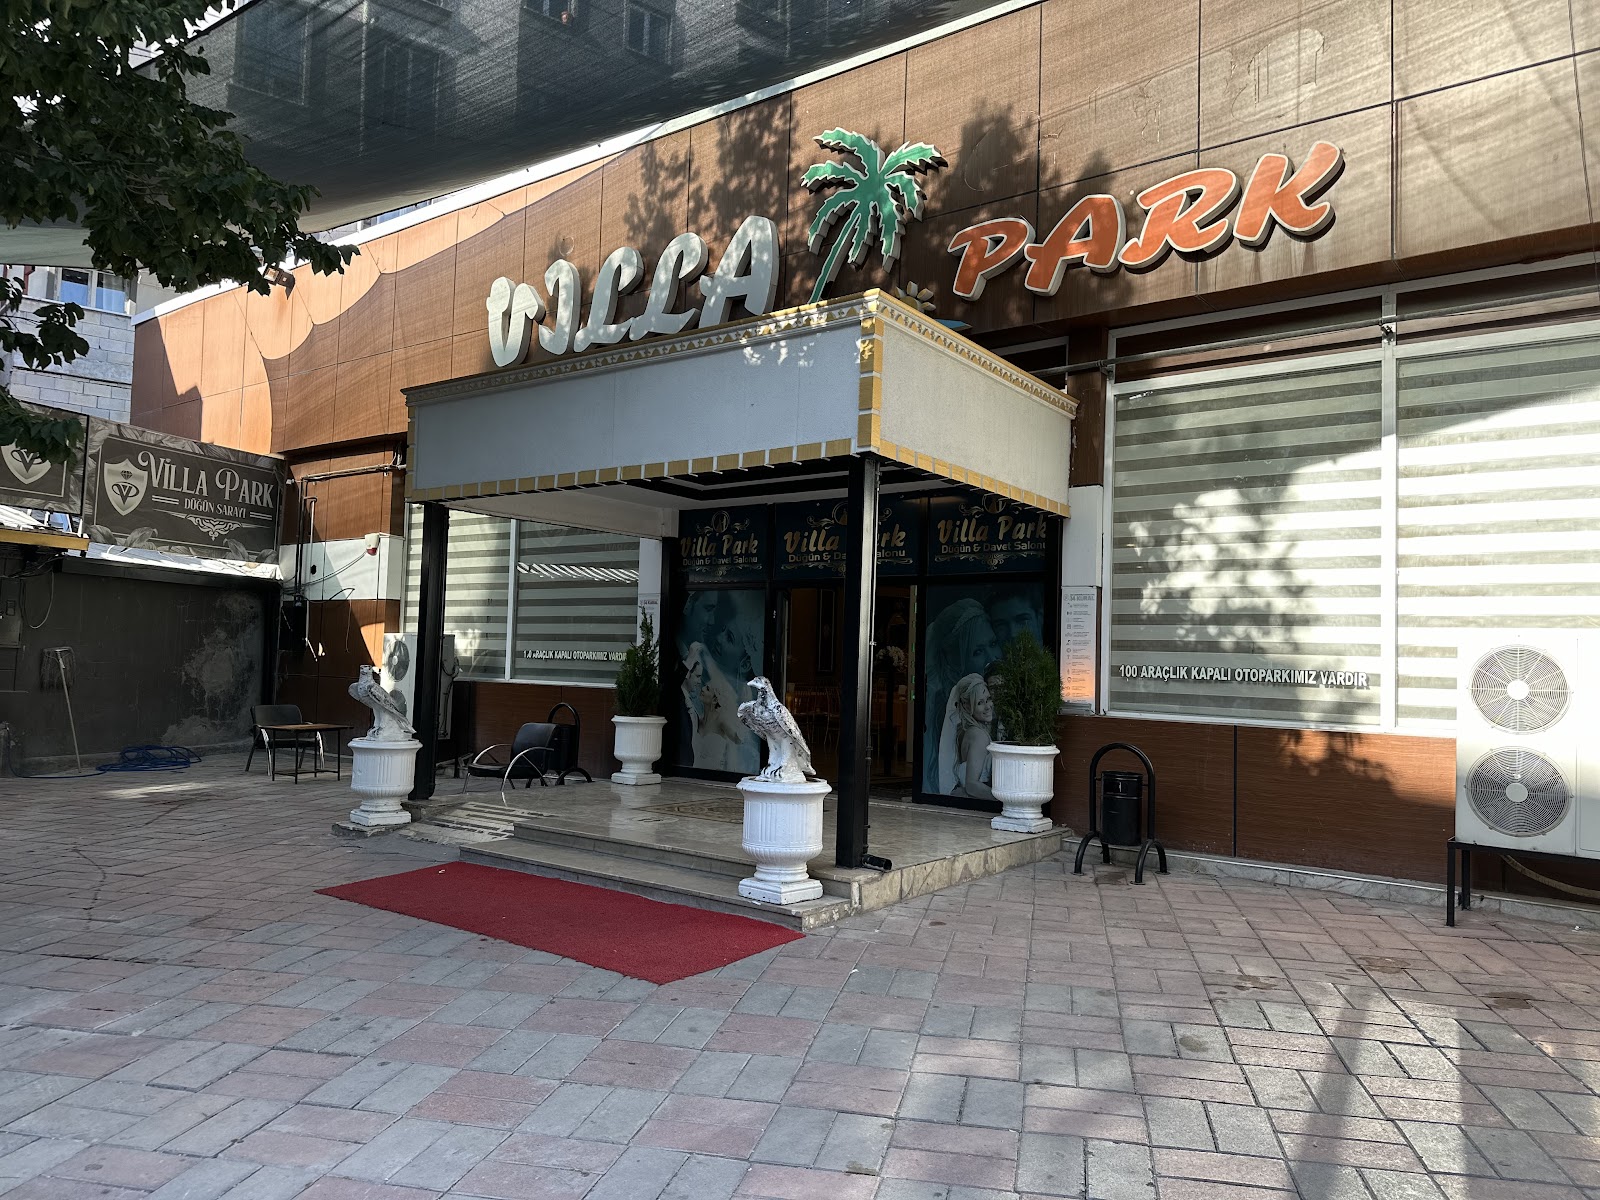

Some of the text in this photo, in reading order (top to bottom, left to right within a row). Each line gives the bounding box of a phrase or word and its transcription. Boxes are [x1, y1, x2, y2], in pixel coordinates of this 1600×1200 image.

[486, 140, 1344, 367] VILLA PARK
[215, 467, 274, 509] PARK
[184, 497, 246, 519] DÜĞÜN SARAYI
[783, 523, 907, 554] Villa rk
[937, 514, 1047, 545] Villa Park
[680, 532, 759, 558] Villa Park
[822, 552, 831, 562] &
[877, 548, 906, 559] alonu
[983, 542, 1012, 553] Davet
[733, 554, 758, 565] Salonu
[554, 650, 572, 660] KAPALI
[1119, 664, 1368, 686] 100 ARAÇLIK KAPALI OTOPARKIMIZ VARDIR
